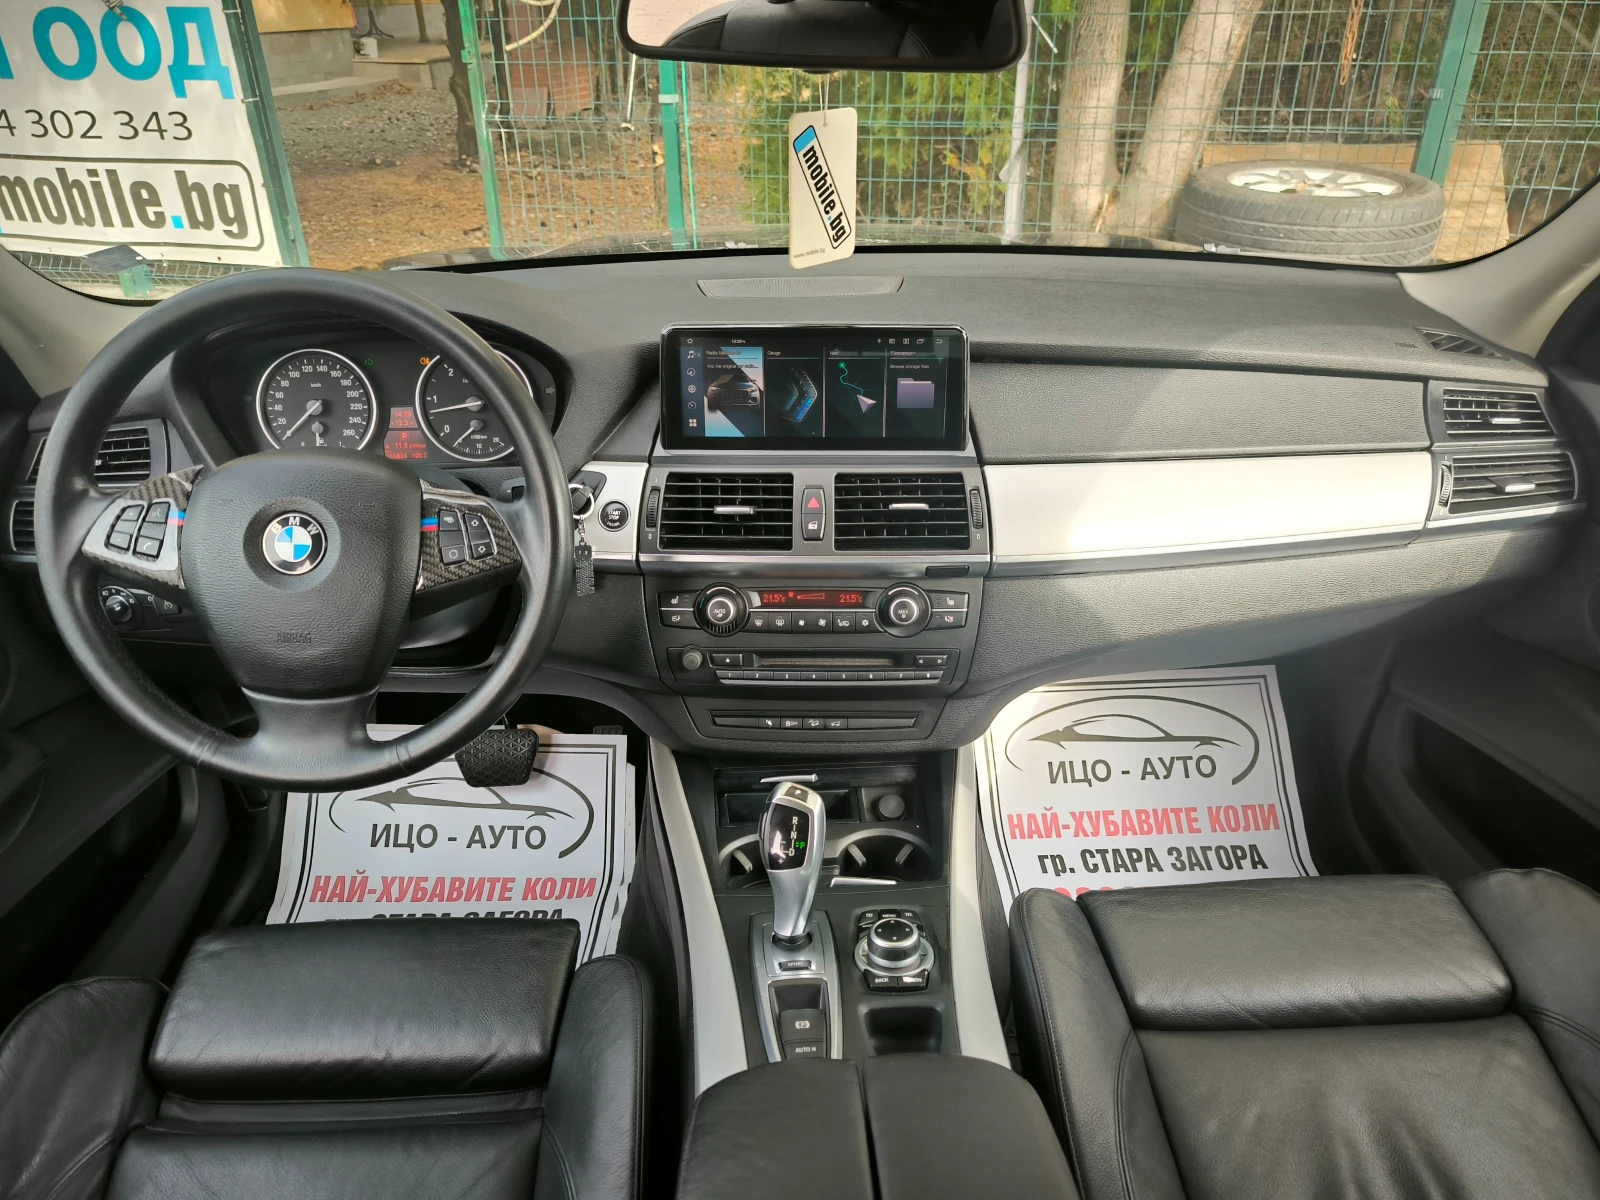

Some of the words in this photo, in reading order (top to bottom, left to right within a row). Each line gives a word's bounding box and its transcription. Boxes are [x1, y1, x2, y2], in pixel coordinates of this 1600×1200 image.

[33, 6, 235, 99] ООД
[25, 109, 103, 139] 302
[113, 110, 193, 140] 343
[0, 167, 249, 240] mobile.bg
[802, 145, 847, 243] mobile.bg
[448, 368, 454, 376] 2
[432, 396, 438, 404] 1
[401, 432, 408, 440] P
[444, 424, 450, 433] 0
[270, 516, 320, 536] BMW
[276, 632, 312, 644] AIRBAG
[1047, 760, 1112, 788] ИЦО
[1140, 754, 1217, 781] АУТО
[792, 816, 798, 825] R
[1007, 806, 1202, 840] НАЙ-ХУБАВИТЕ
[1206, 803, 1280, 834] КОЛИ
[370, 824, 438, 853] ИЦО
[466, 824, 547, 850] АУТО
[790, 831, 798, 840] N
[788, 848, 795, 856] D
[1038, 852, 1076, 877] гр.
[1080, 846, 1164, 874] СТАРА
[1167, 844, 1269, 872] ЗАГОРА
[309, 869, 514, 903] НАЙ-ХУБАВИТЕ
[522, 877, 597, 901] КОЛИ
